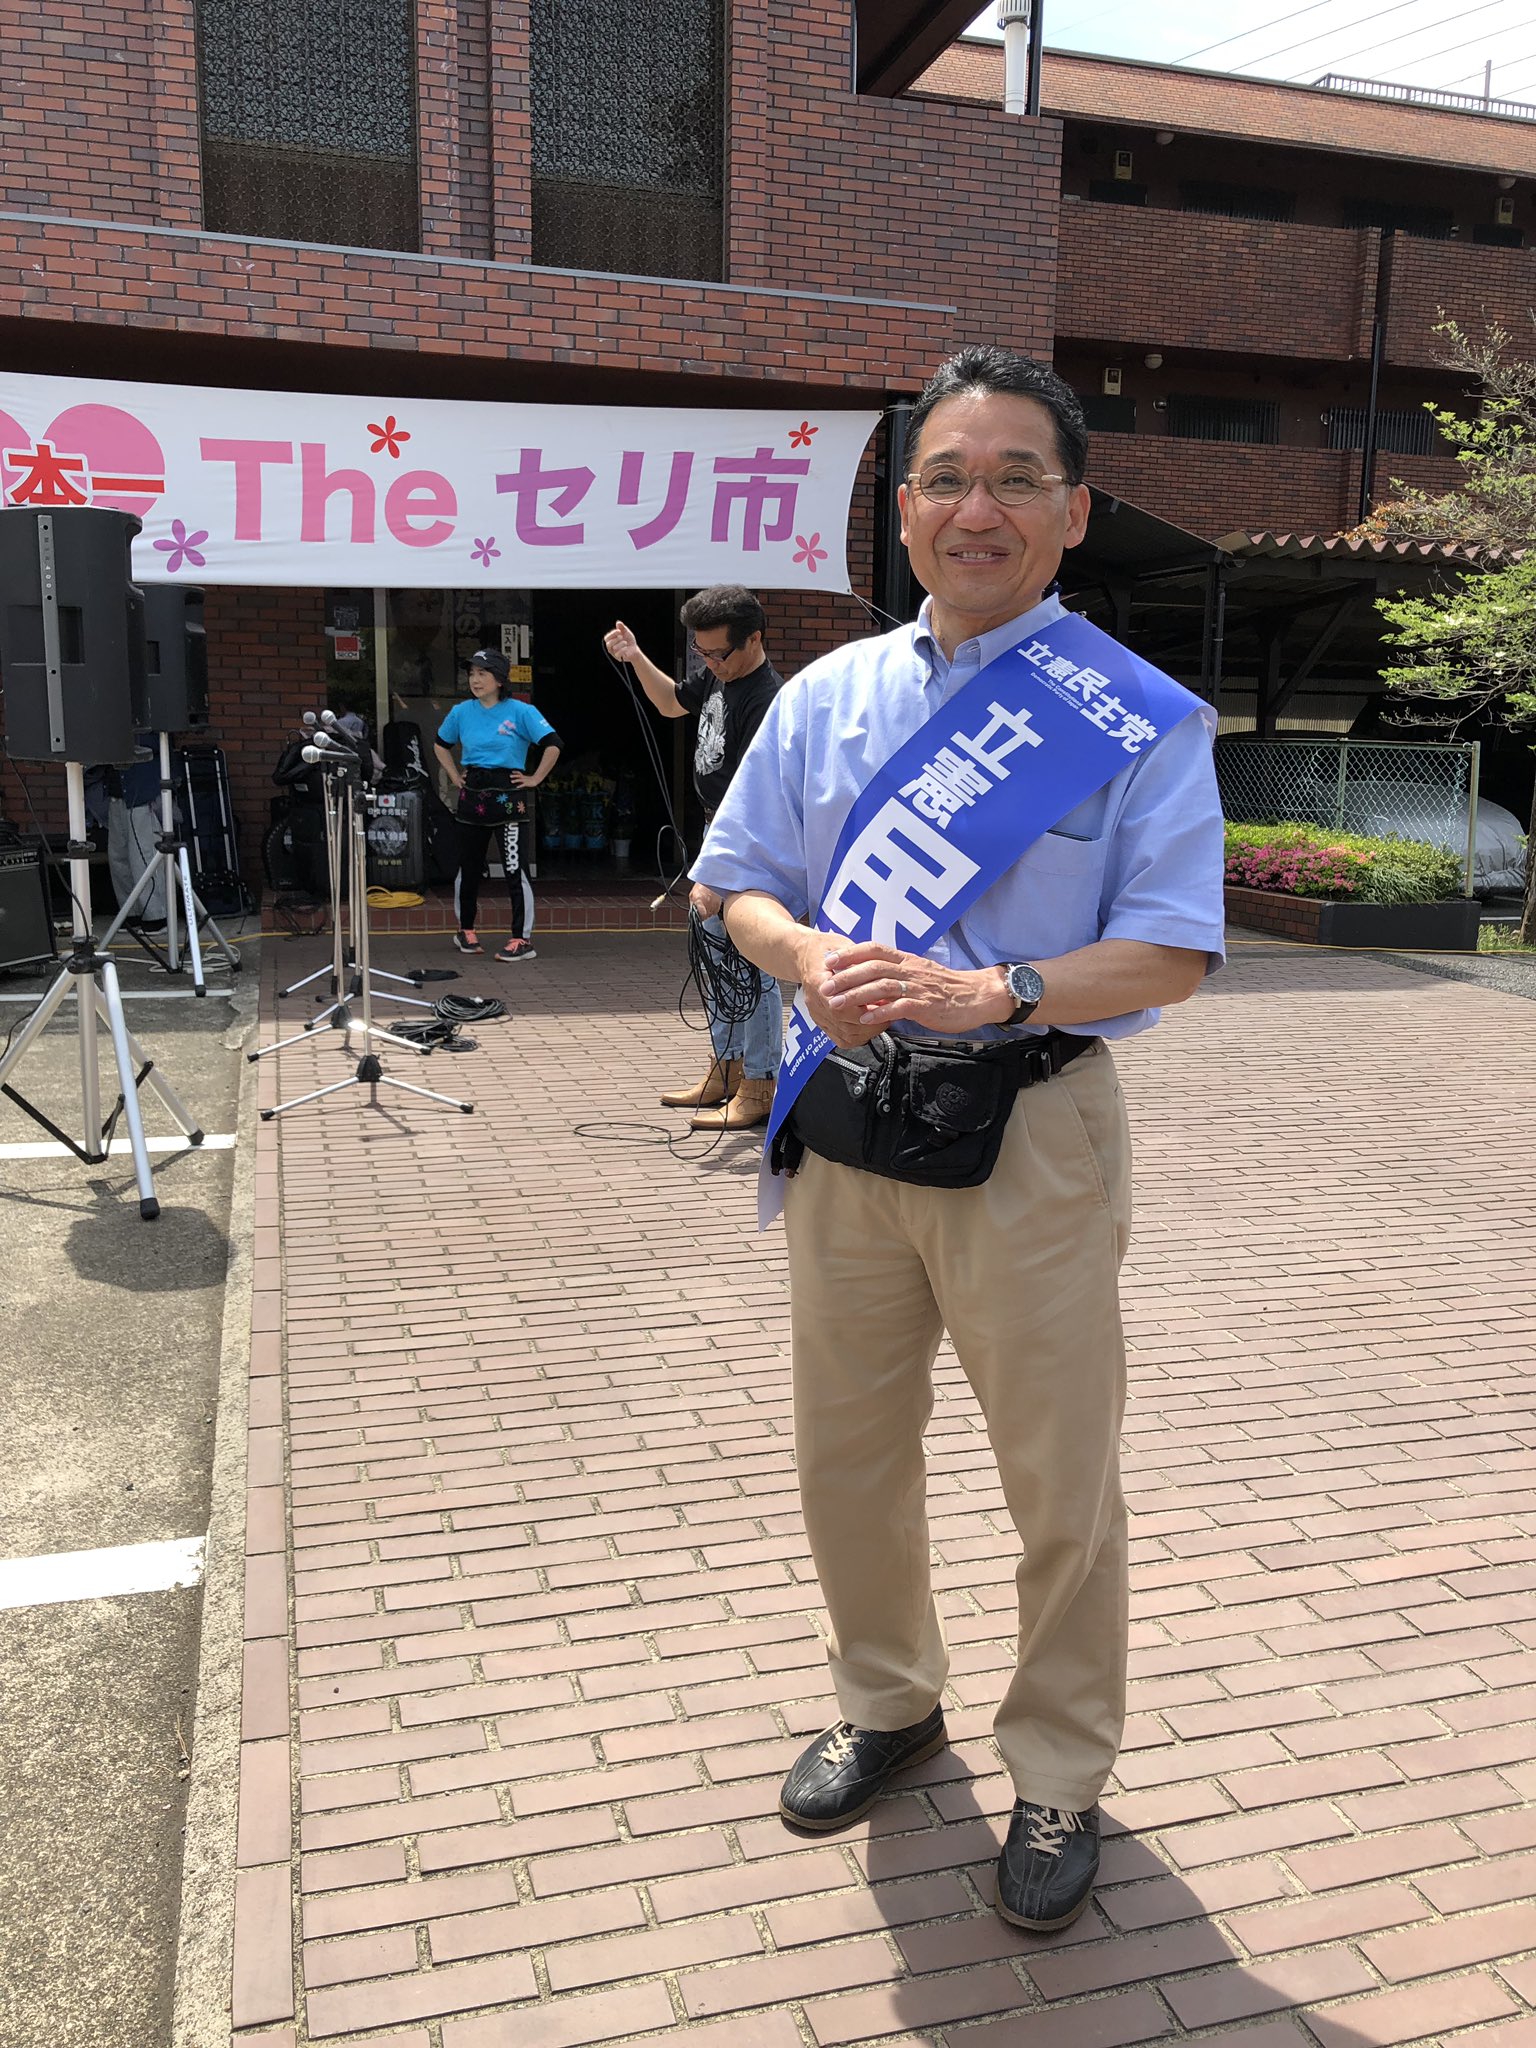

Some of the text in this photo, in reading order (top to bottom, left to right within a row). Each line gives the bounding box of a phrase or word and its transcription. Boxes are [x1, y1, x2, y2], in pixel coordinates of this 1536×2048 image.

[200, 437, 457, 548] The
[496, 447, 811, 551] セリ市
[1017, 640, 1158, 753] 立憲民主党
[183, 875, 194, 926] ULTIMATE
[789, 1051, 806, 1077] Japan
[805, 1044, 813, 1055] of
